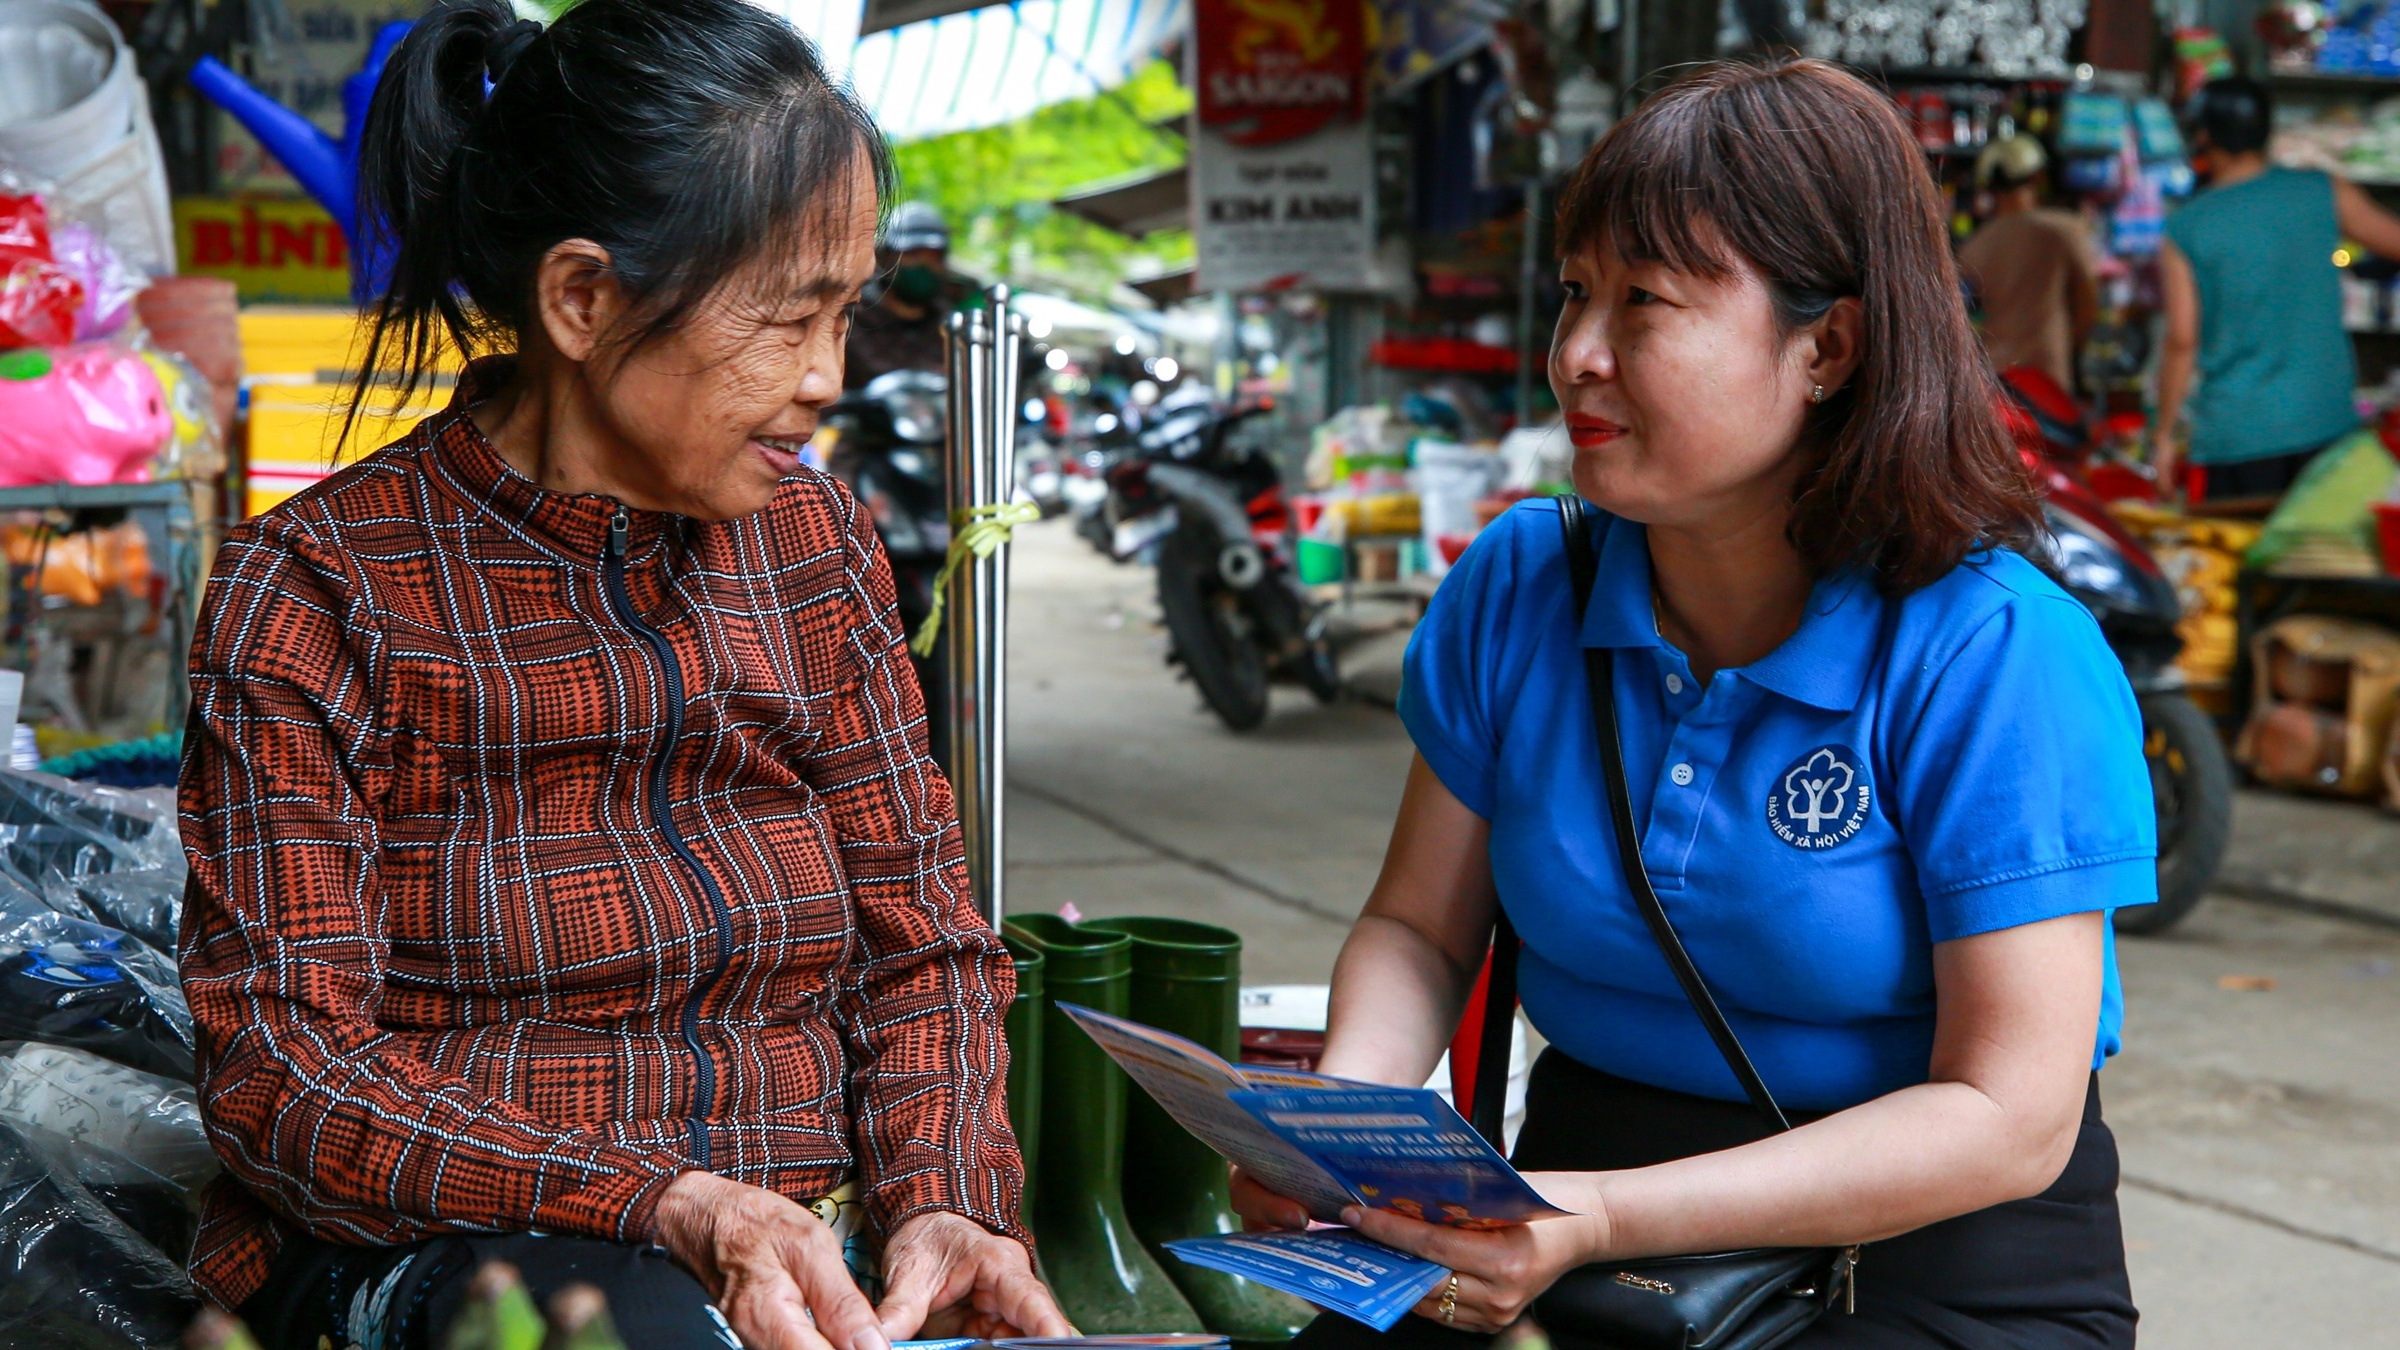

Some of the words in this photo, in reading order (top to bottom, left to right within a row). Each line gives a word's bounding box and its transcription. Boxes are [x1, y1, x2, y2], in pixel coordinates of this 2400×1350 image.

[1209, 71, 1349, 105] SAIGON
[1208, 196, 1275, 222] KIM
[1284, 195, 1362, 221] ANH
[1767, 795, 1779, 816] BẢO
[1857, 785, 1869, 813] NAM
[1771, 817, 1795, 842] HIỂM
[1840, 812, 1863, 839] VIỆT
[1795, 835, 1811, 848] XÃ
[1815, 832, 1840, 848] HỘI
